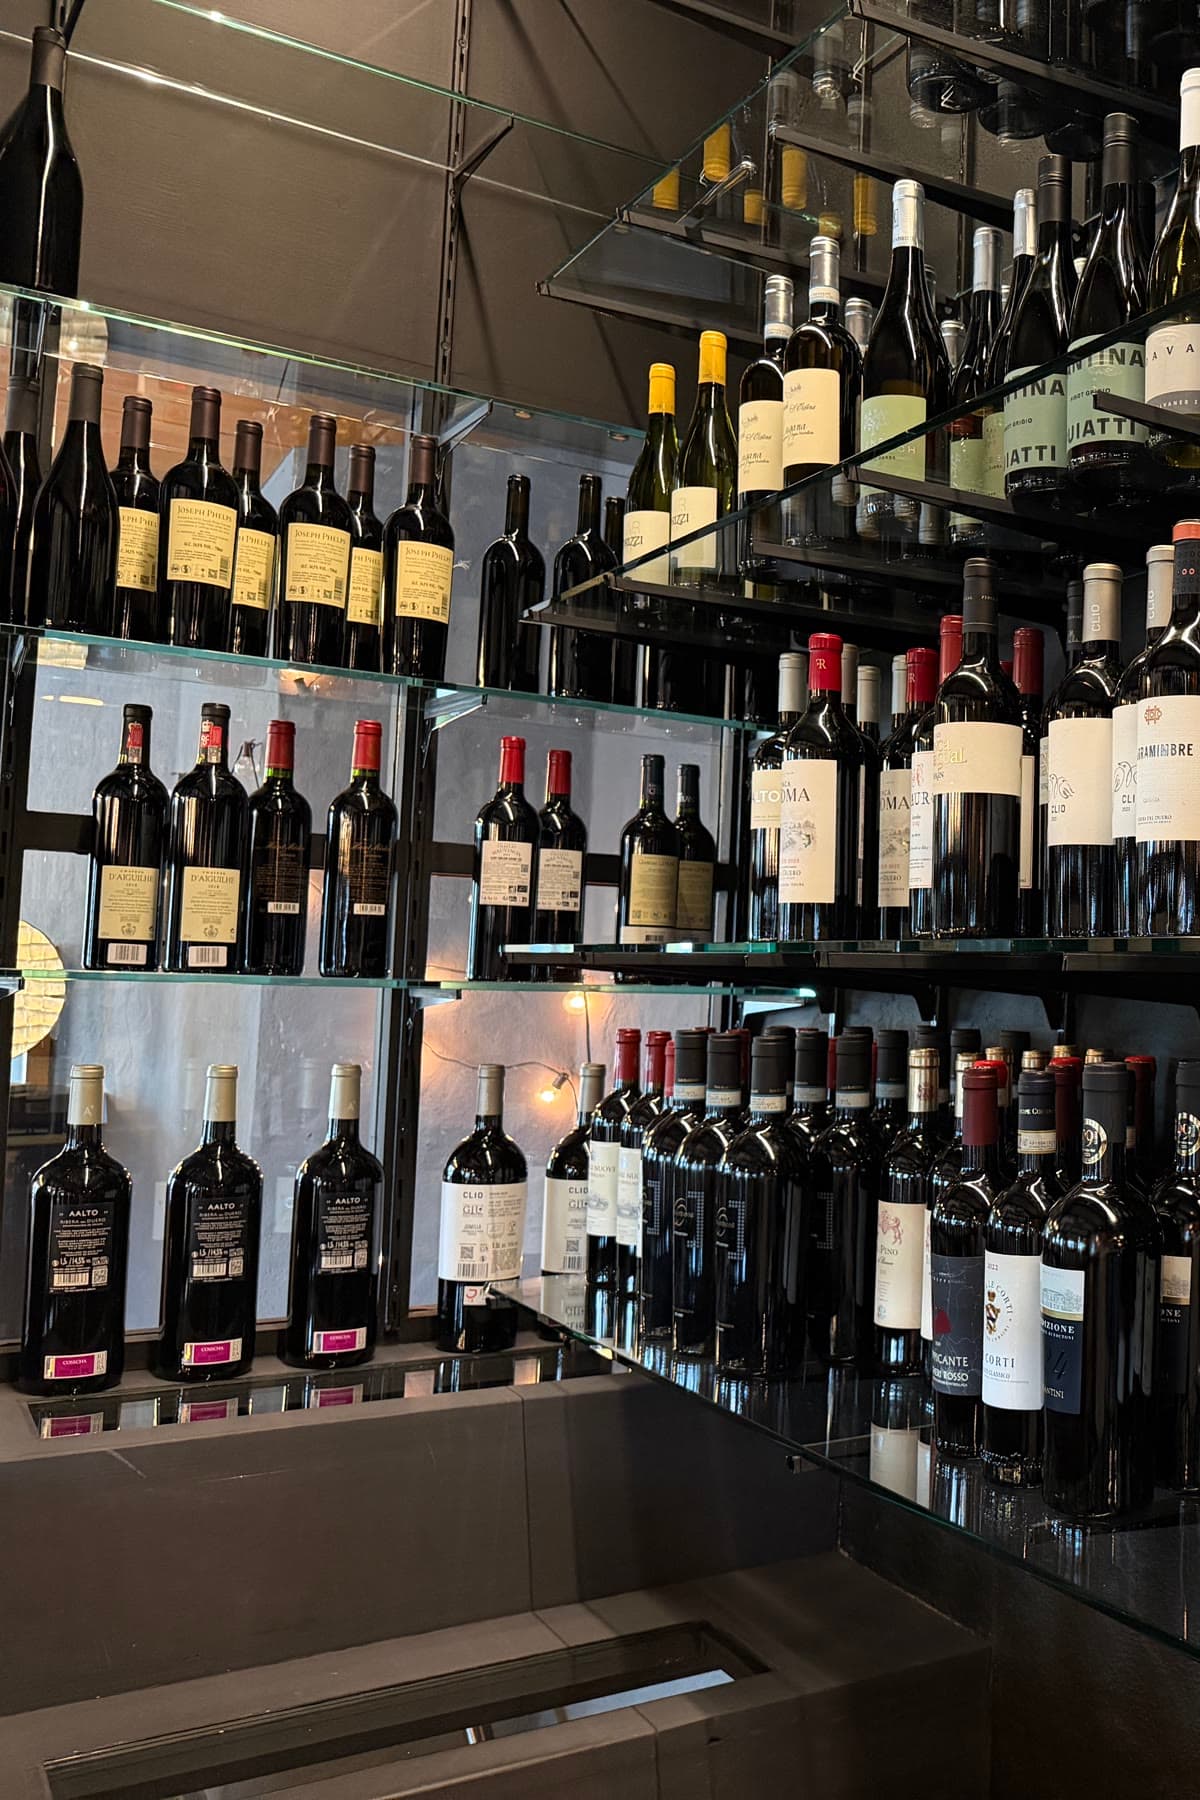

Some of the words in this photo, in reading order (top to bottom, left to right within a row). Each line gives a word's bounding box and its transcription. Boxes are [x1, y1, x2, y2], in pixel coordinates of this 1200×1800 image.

[176, 504, 206, 517] JOSEPH
[206, 508, 233, 523] PHELPS
[294, 528, 323, 540] JOSEPH
[323, 532, 347, 545] PHELPS
[405, 546, 431, 557] JOSEPH
[1090, 603, 1101, 632] CLIO
[335, 1196, 361, 1205] AALTO
[463, 1191, 484, 1200] CLIO
[207, 1202, 236, 1211] AALTO
[68, 1209, 99, 1218] AALTO
